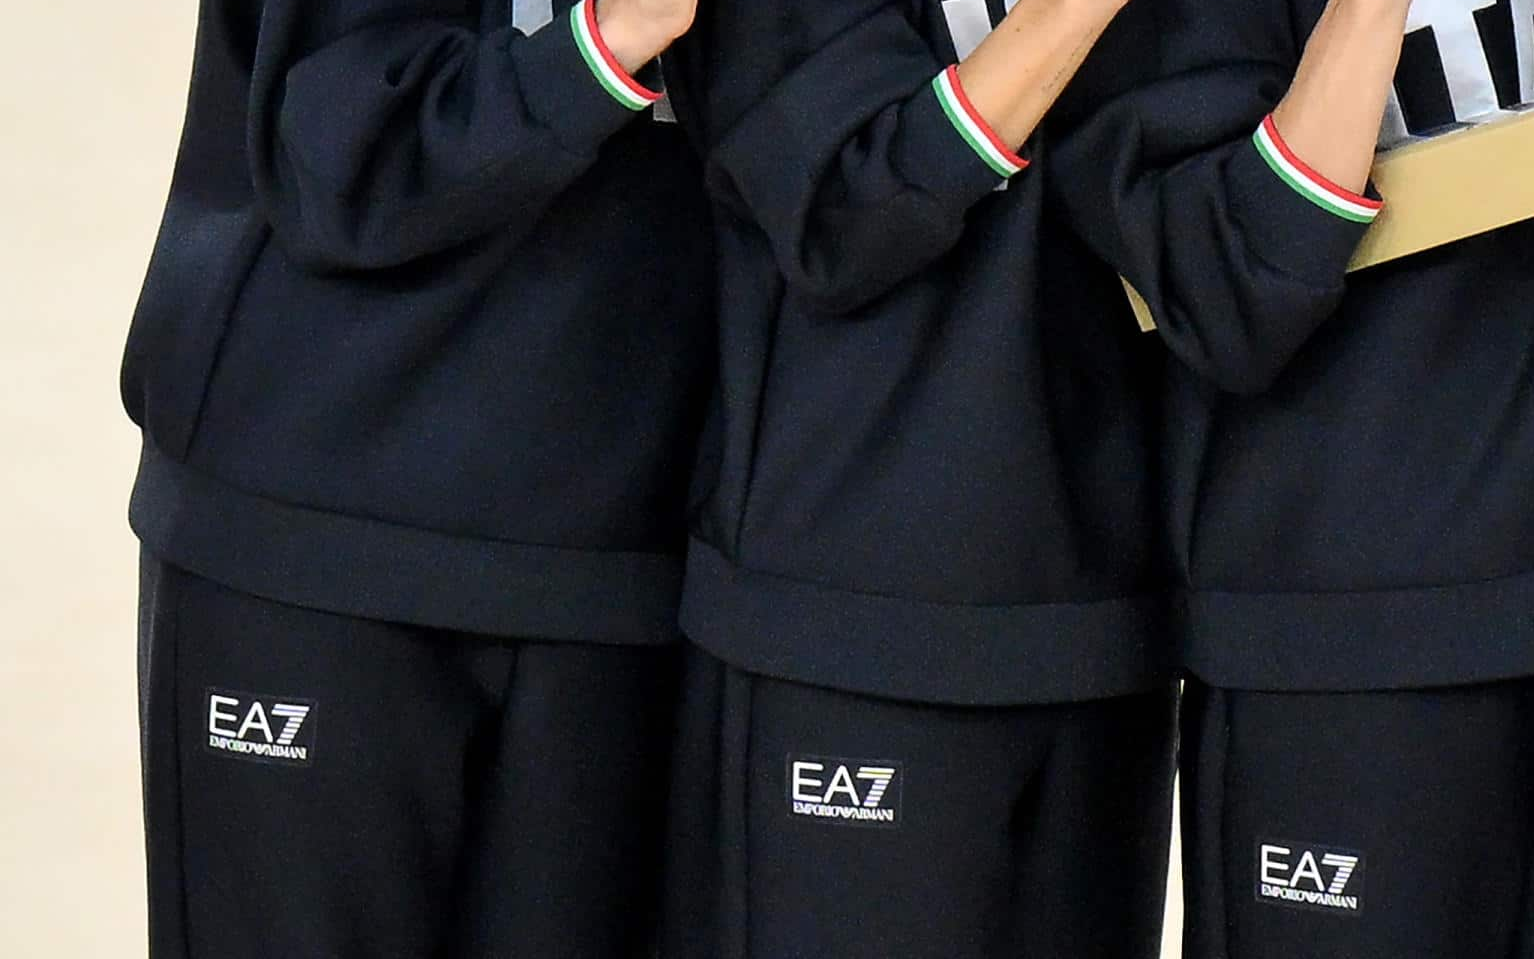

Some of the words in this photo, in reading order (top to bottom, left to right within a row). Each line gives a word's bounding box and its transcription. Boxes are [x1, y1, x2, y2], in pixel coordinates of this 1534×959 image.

[209, 694, 310, 746] EA7
[792, 761, 895, 807] EA7
[1261, 844, 1359, 895] EA7
